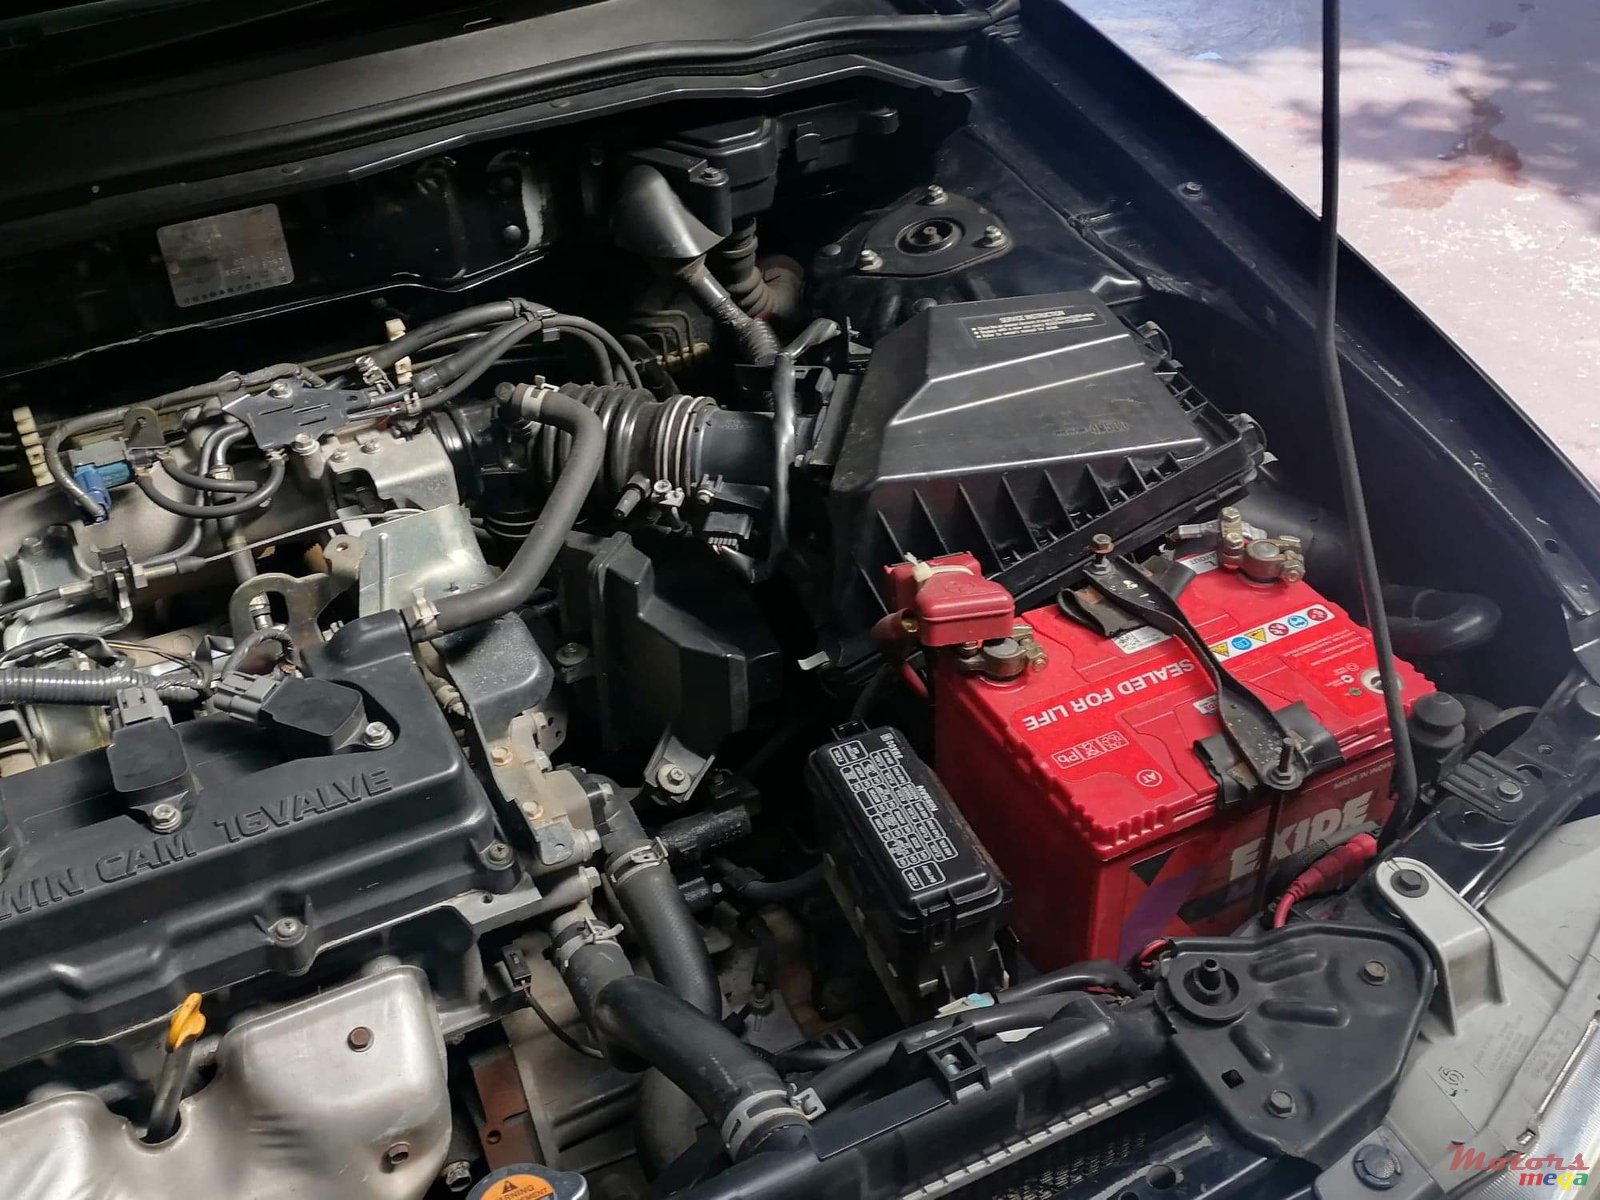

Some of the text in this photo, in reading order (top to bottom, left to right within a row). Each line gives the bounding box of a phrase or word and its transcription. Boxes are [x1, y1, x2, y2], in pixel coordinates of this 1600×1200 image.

[1021, 658, 1196, 731] SEALED FOR LIFE
[1057, 752, 1081, 763] Pb
[96, 831, 197, 884] CAM
[214, 768, 393, 843] 16VALVE
[916, 785, 938, 812] NISSAN
[1230, 790, 1374, 881] EXIDE
